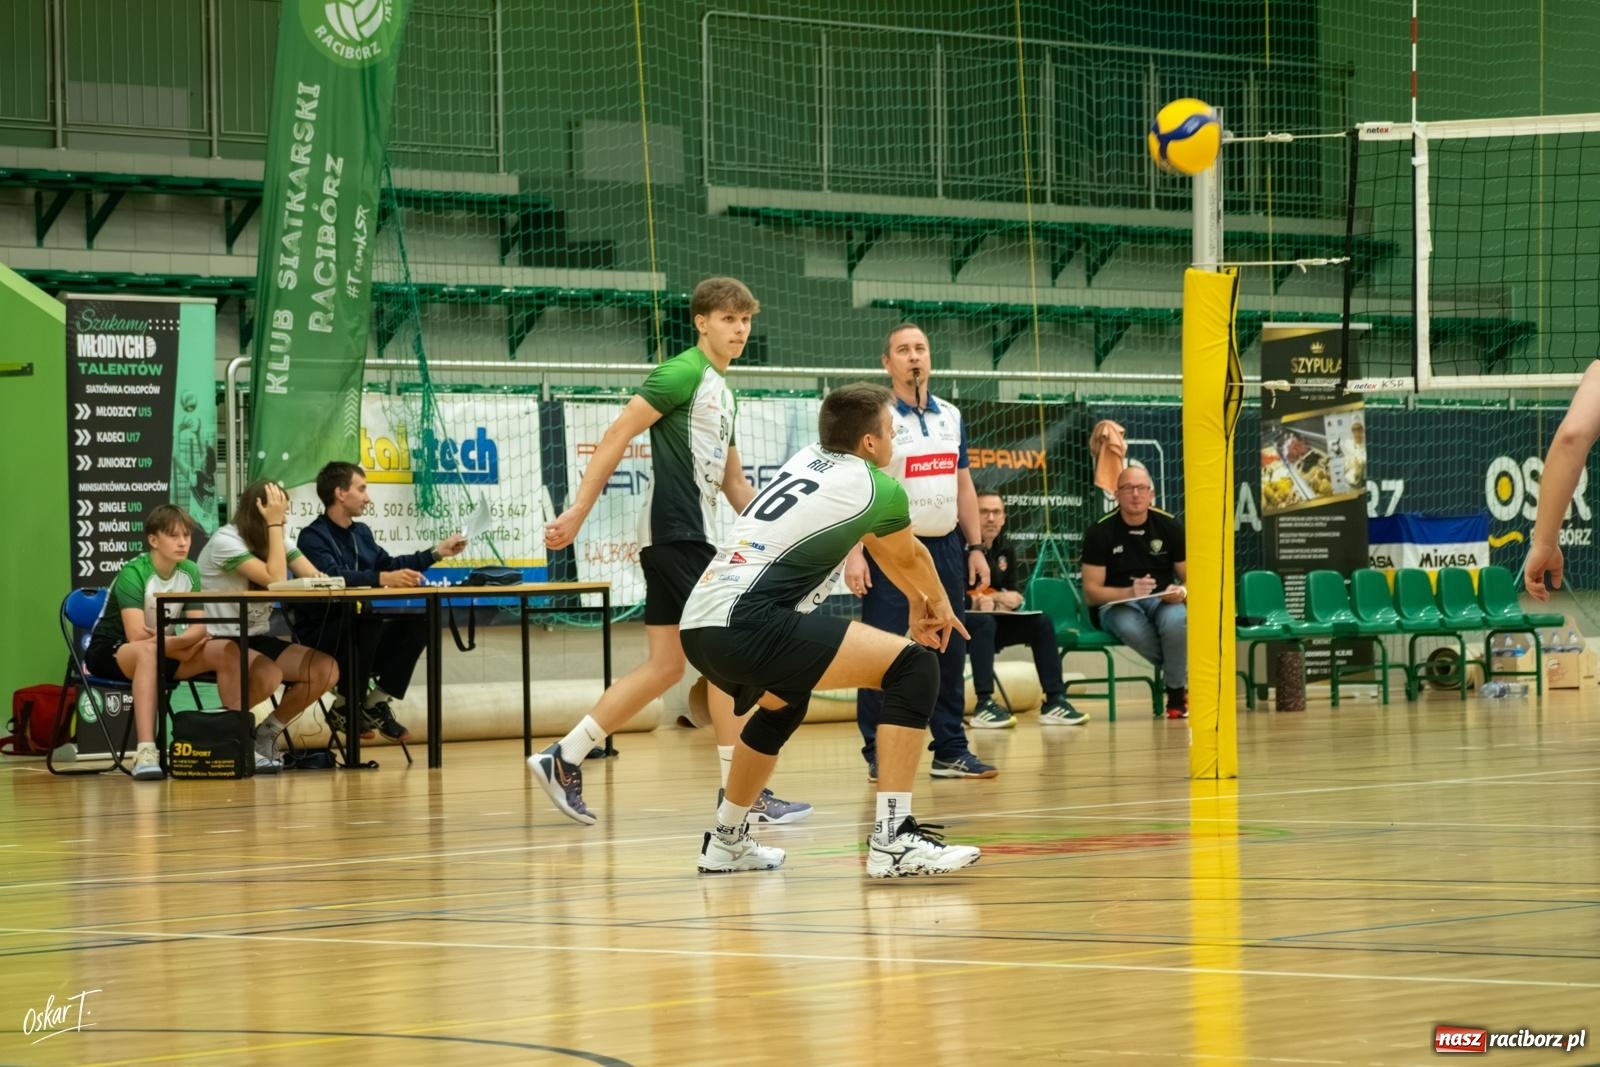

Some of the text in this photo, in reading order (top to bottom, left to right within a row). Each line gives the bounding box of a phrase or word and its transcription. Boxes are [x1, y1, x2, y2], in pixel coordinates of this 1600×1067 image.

[314, 25, 381, 60] RACIBÓRZ
[265, 81, 320, 394] KLUB SIATKARSKI
[308, 152, 344, 333] RACIBÓRZ
[75, 308, 149, 335] Szukamy
[76, 334, 144, 359] MŁODYCH
[78, 361, 163, 376] TALENTÓW
[85, 382, 160, 394] SIATKÓWKA CHŁOPCÓW
[95, 406, 152, 417] MŁODZICY U15
[96, 432, 141, 442] KADECI U17
[360, 424, 498, 471] tal-tech
[97, 457, 153, 468] JUNIORZY U19
[78, 480, 168, 492] MINISIATKÓWKA CHŁOPCÓW
[741, 471, 820, 522] 16
[98, 502, 142, 513] SINGLE U10
[300, 502, 313, 517] 32
[383, 503, 404, 518] 502
[508, 504, 527, 518] 647
[98, 518, 144, 532] DWÓJKI U11
[98, 538, 143, 552] TRÓJKI U12
[1369, 555, 1395, 569] ASA
